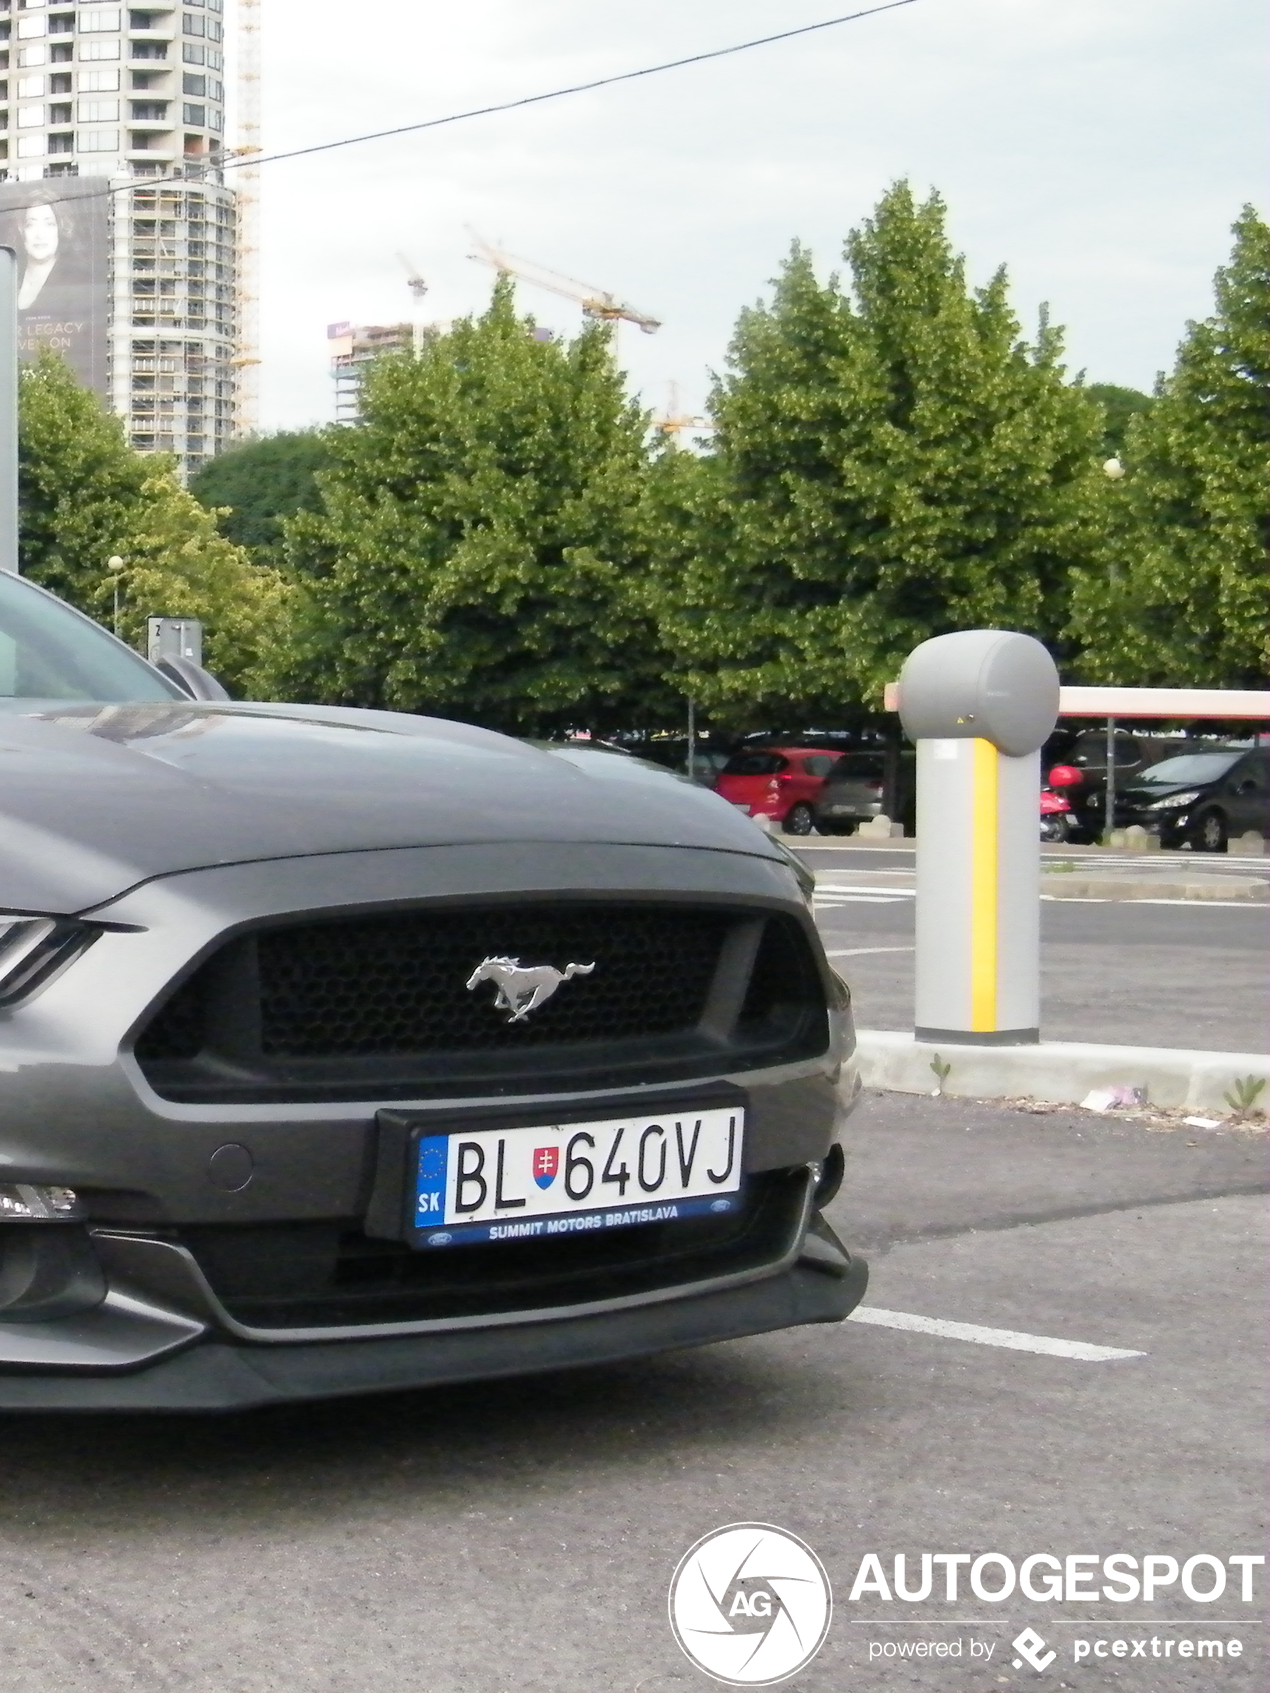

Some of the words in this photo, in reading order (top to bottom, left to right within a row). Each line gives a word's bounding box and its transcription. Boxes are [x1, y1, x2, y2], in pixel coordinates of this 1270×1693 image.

[27, 322, 84, 336] LEGACY
[50, 336, 71, 349] ON
[454, 1139, 526, 1214] BL
[564, 1116, 736, 1201] 640VJ
[418, 1192, 440, 1213] SK
[489, 1222, 544, 1240] SUMMIT
[547, 1215, 602, 1233] MOTORS
[605, 1206, 679, 1227] BRATISLAVA
